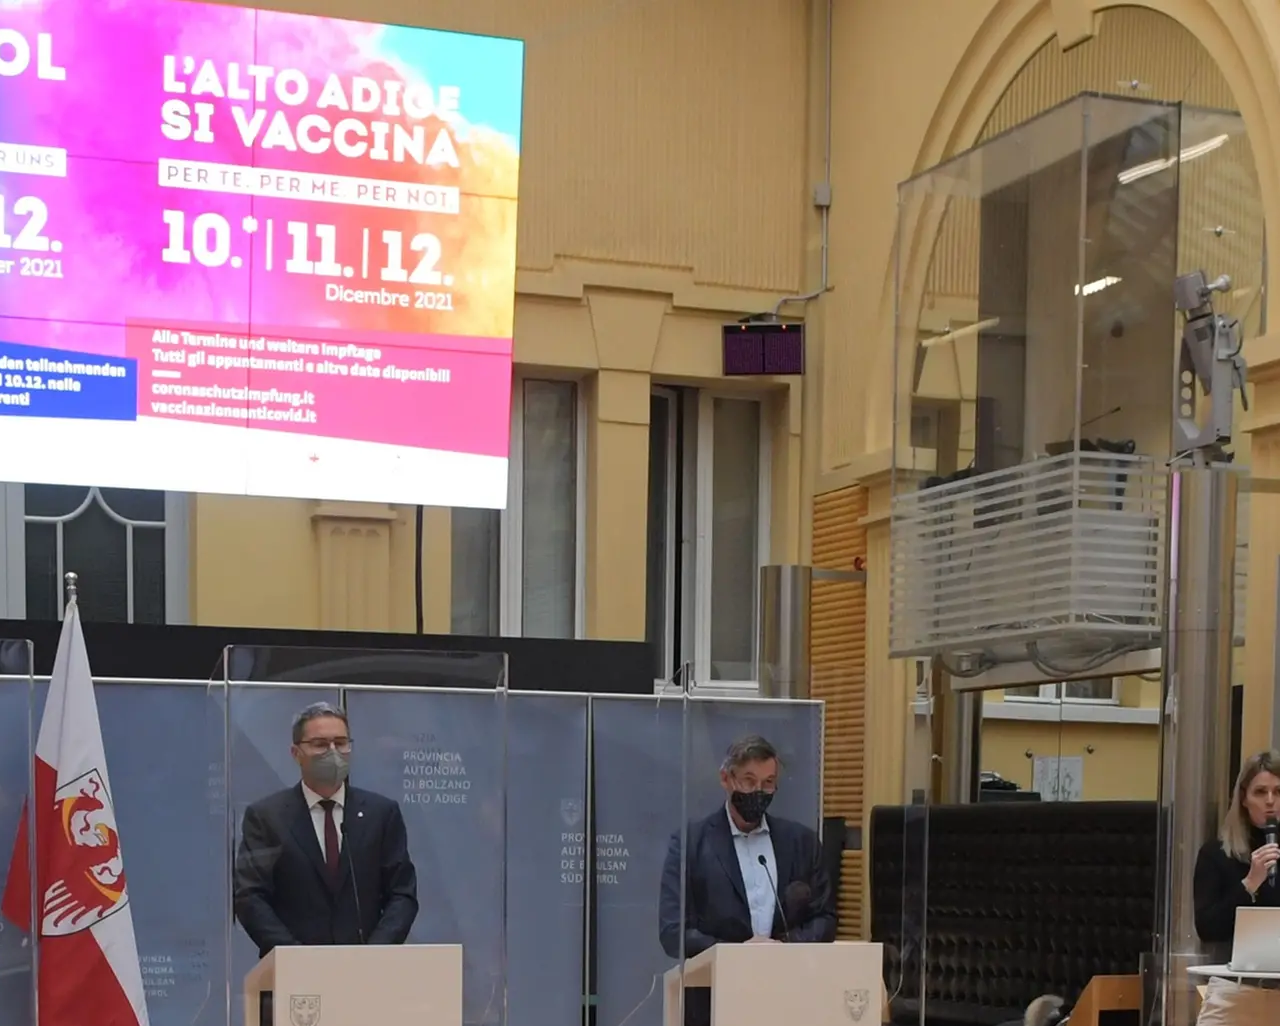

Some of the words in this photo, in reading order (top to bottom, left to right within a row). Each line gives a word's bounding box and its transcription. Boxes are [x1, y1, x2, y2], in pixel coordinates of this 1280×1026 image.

[317, 73, 461, 121] ADIGE
[161, 99, 214, 143] SI
[231, 106, 460, 168] VACCINA
[167, 165, 209, 184] PER
[259, 174, 301, 193] PER
[357, 184, 396, 202] PER
[285, 221, 354, 278] 11.
[381, 229, 454, 286] 12.
[20, 256, 64, 278] 2021
[325, 284, 409, 307] Dicembre
[414, 292, 453, 311] 2021
[152, 329, 179, 344] Alle
[181, 331, 237, 349] Termine
[239, 337, 264, 351] und
[267, 338, 319, 355] weitere
[25, 358, 126, 377] teilnehmenden
[152, 348, 185, 364] Tutti
[188, 351, 205, 367] gli
[207, 353, 304, 373] appuntamenti
[306, 361, 314, 372] e
[316, 360, 348, 375] altre
[350, 363, 380, 378] date
[383, 365, 451, 383] disponibili
[5, 375, 46, 389] 10.12.
[152, 382, 315, 407] coronaschutzimpfung.it
[151, 401, 317, 423] vaccinazioneanticovid.it
[403, 750, 462, 762] PROVINCIA
[403, 765, 466, 775] AUTONOMA
[403, 779, 415, 789] DI
[419, 780, 471, 789] BOLZANO
[403, 793, 431, 803] ALTO
[434, 794, 468, 804] ADIGE
